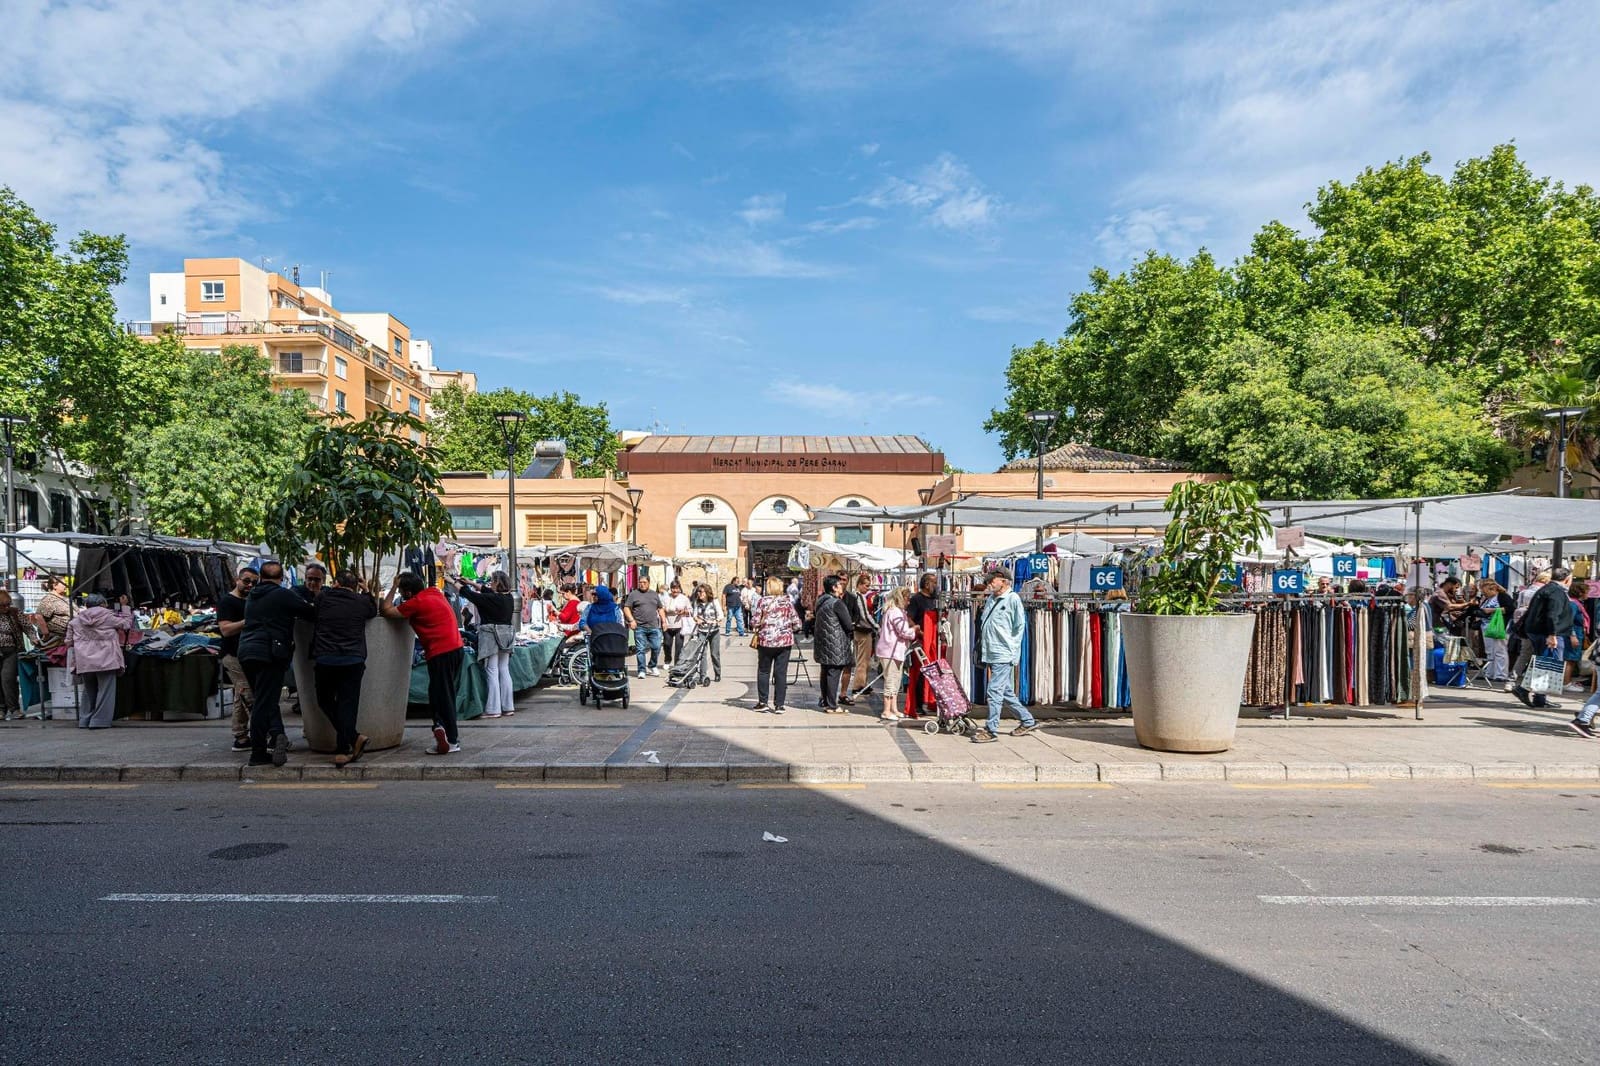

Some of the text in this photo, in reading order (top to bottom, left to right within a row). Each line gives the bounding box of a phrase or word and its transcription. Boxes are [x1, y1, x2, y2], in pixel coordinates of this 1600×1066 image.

[1029, 558, 1048, 570] 15€
[1337, 560, 1353, 573] 6€
[1096, 571, 1116, 586] 6€
[1278, 574, 1298, 589] 6€
